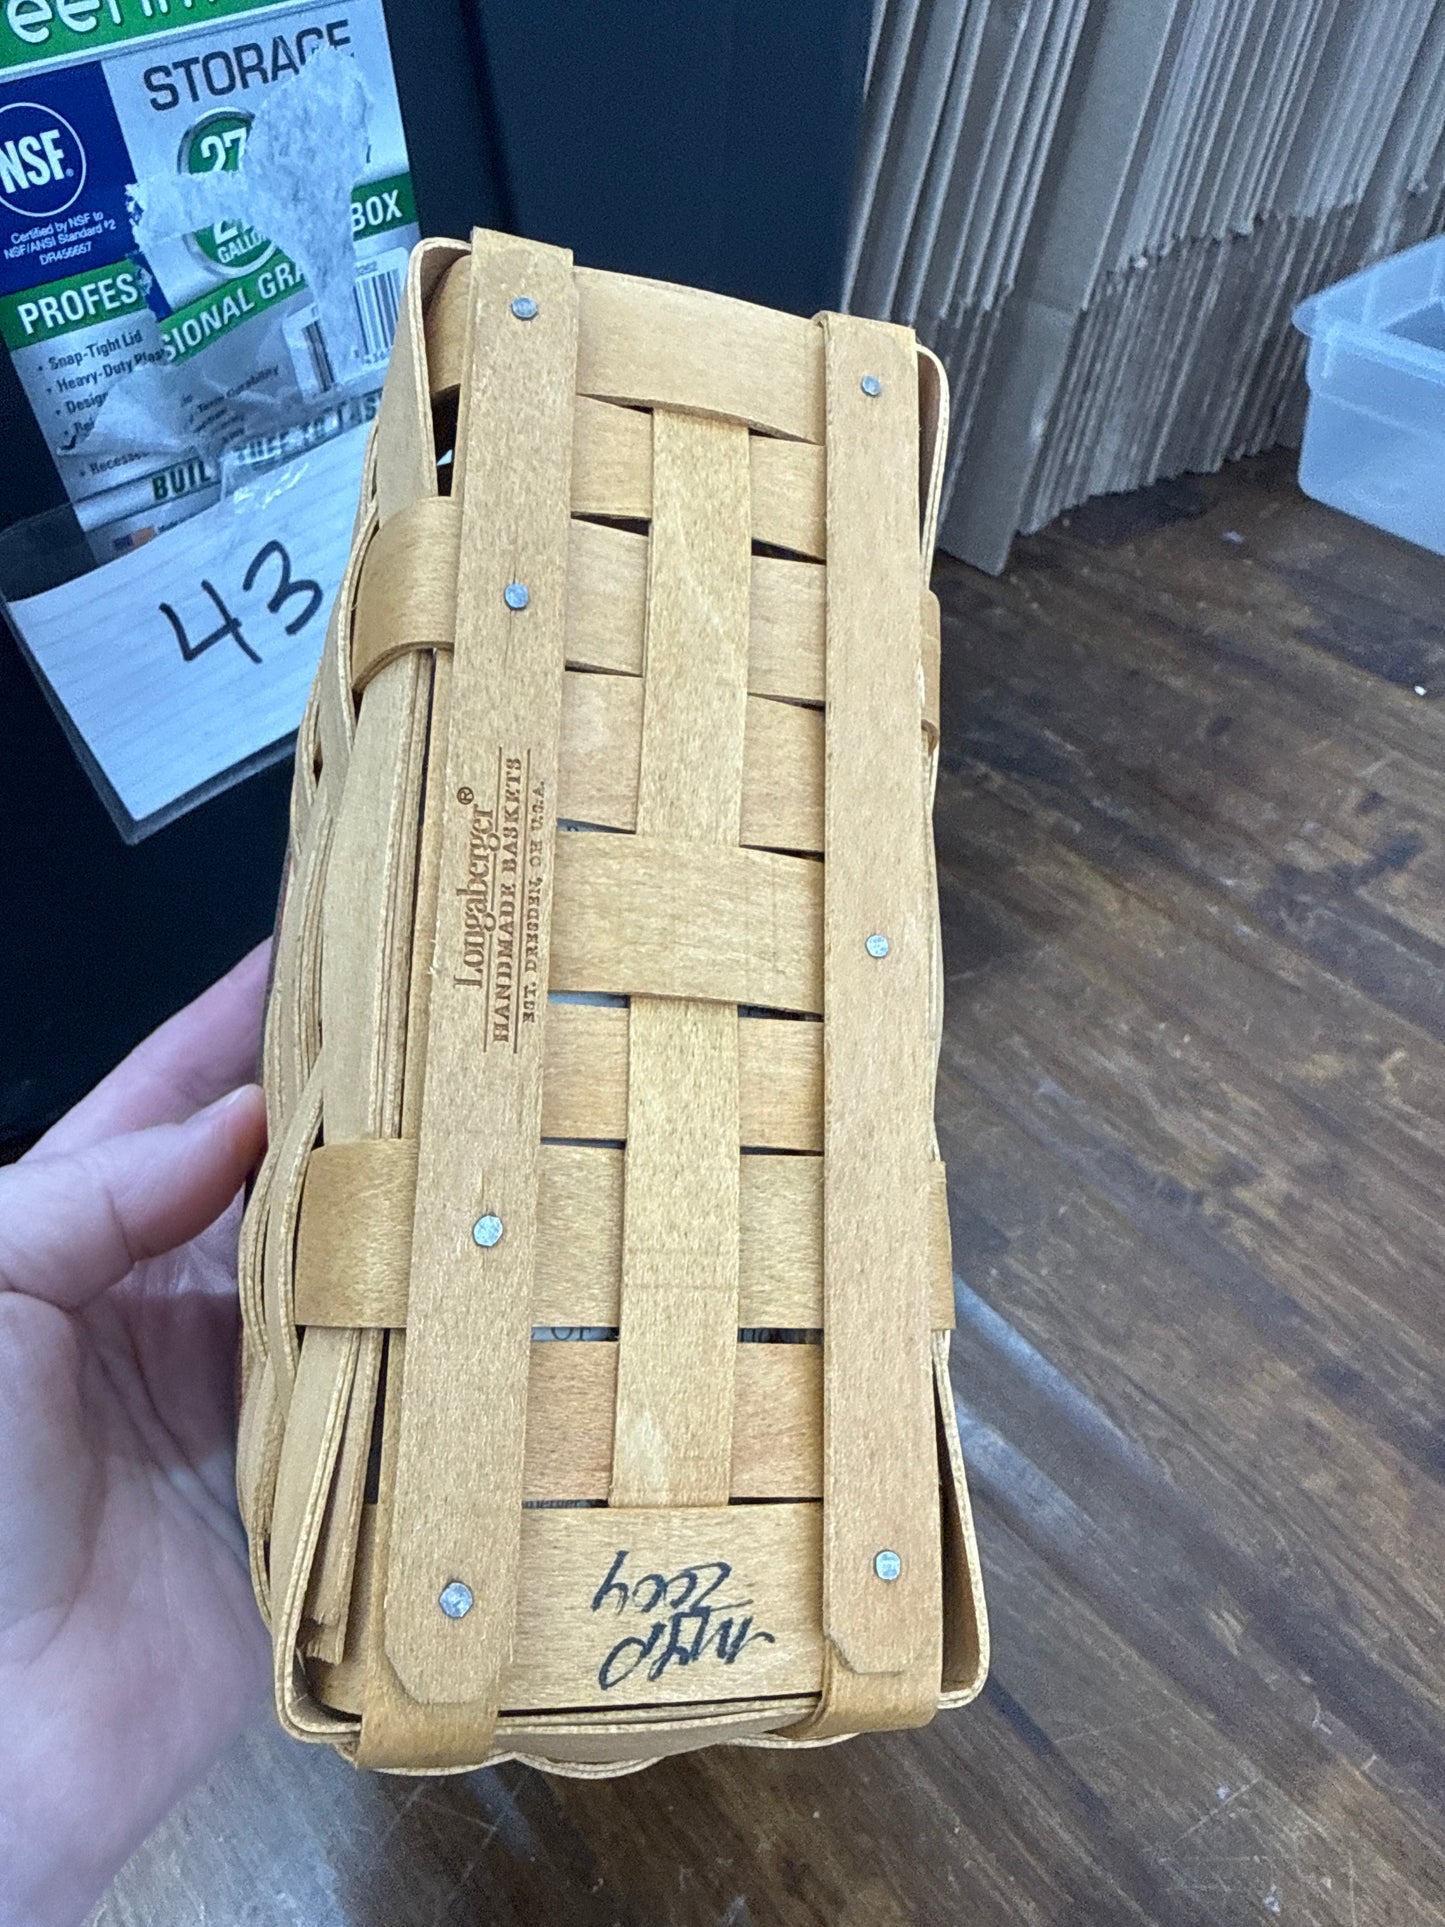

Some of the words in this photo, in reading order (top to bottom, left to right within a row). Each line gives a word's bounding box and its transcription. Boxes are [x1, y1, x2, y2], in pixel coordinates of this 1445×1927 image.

[4, 236, 57, 260] NSF/ANSI
[57, 223, 103, 244] Standard
[11, 223, 54, 244] Certified
[55, 221, 68, 233] by
[68, 213, 91, 228] NSF
[92, 211, 104, 222] to
[48, 338, 121, 370] Snap-Tight
[121, 330, 143, 348] Lid
[56, 360, 133, 393] Heavy-Duty
[152, 459, 212, 501] BUIL
[159, 540, 324, 664] 43
[502, 757, 522, 876] BASKETS
[529, 840, 541, 868] OH
[492, 882, 517, 1043] HANDMADE
[522, 981, 538, 1023] EST.
